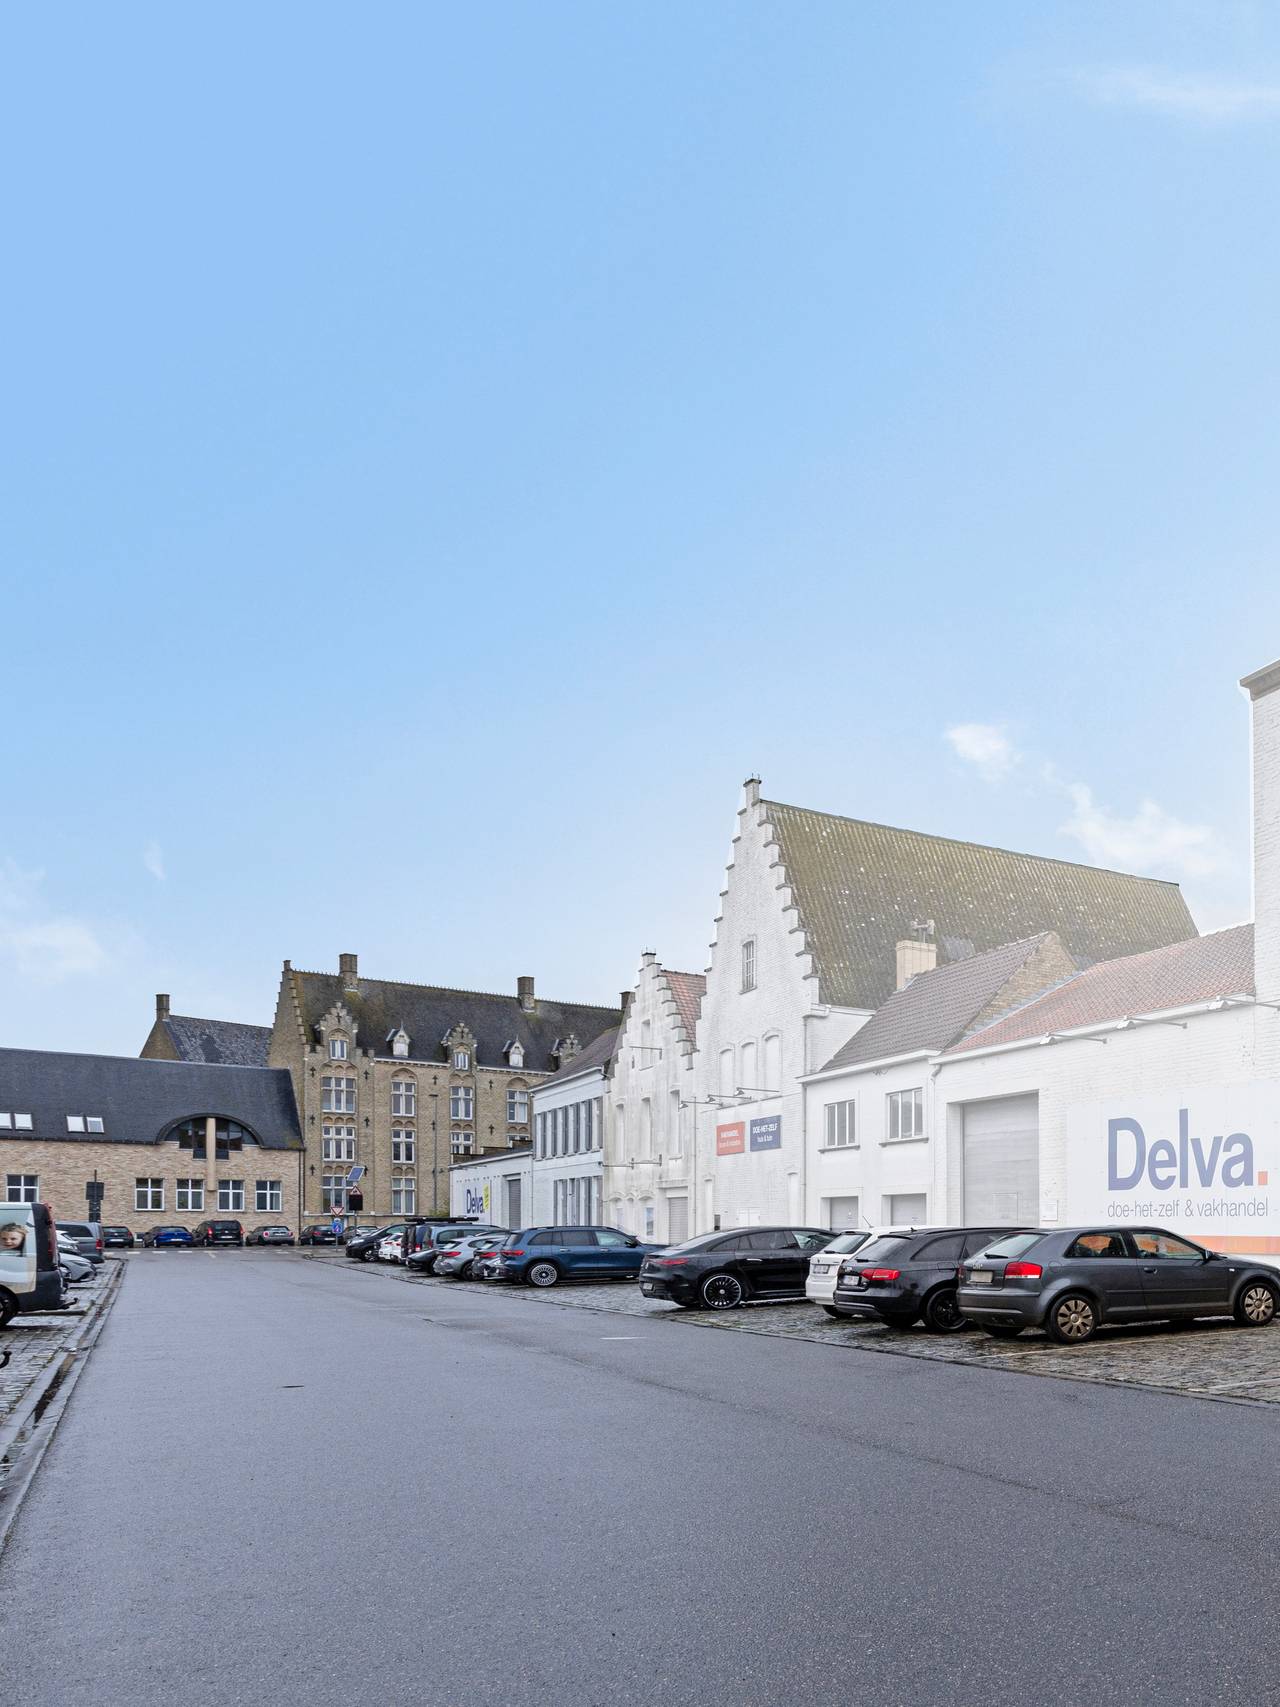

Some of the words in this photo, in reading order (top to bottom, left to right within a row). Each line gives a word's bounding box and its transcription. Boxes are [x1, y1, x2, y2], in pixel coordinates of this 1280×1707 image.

[1107, 1199, 1180, 1217] doe-het-zelf
[1184, 1199, 1194, 1217] &
[1197, 1196, 1268, 1217] vakhandel
